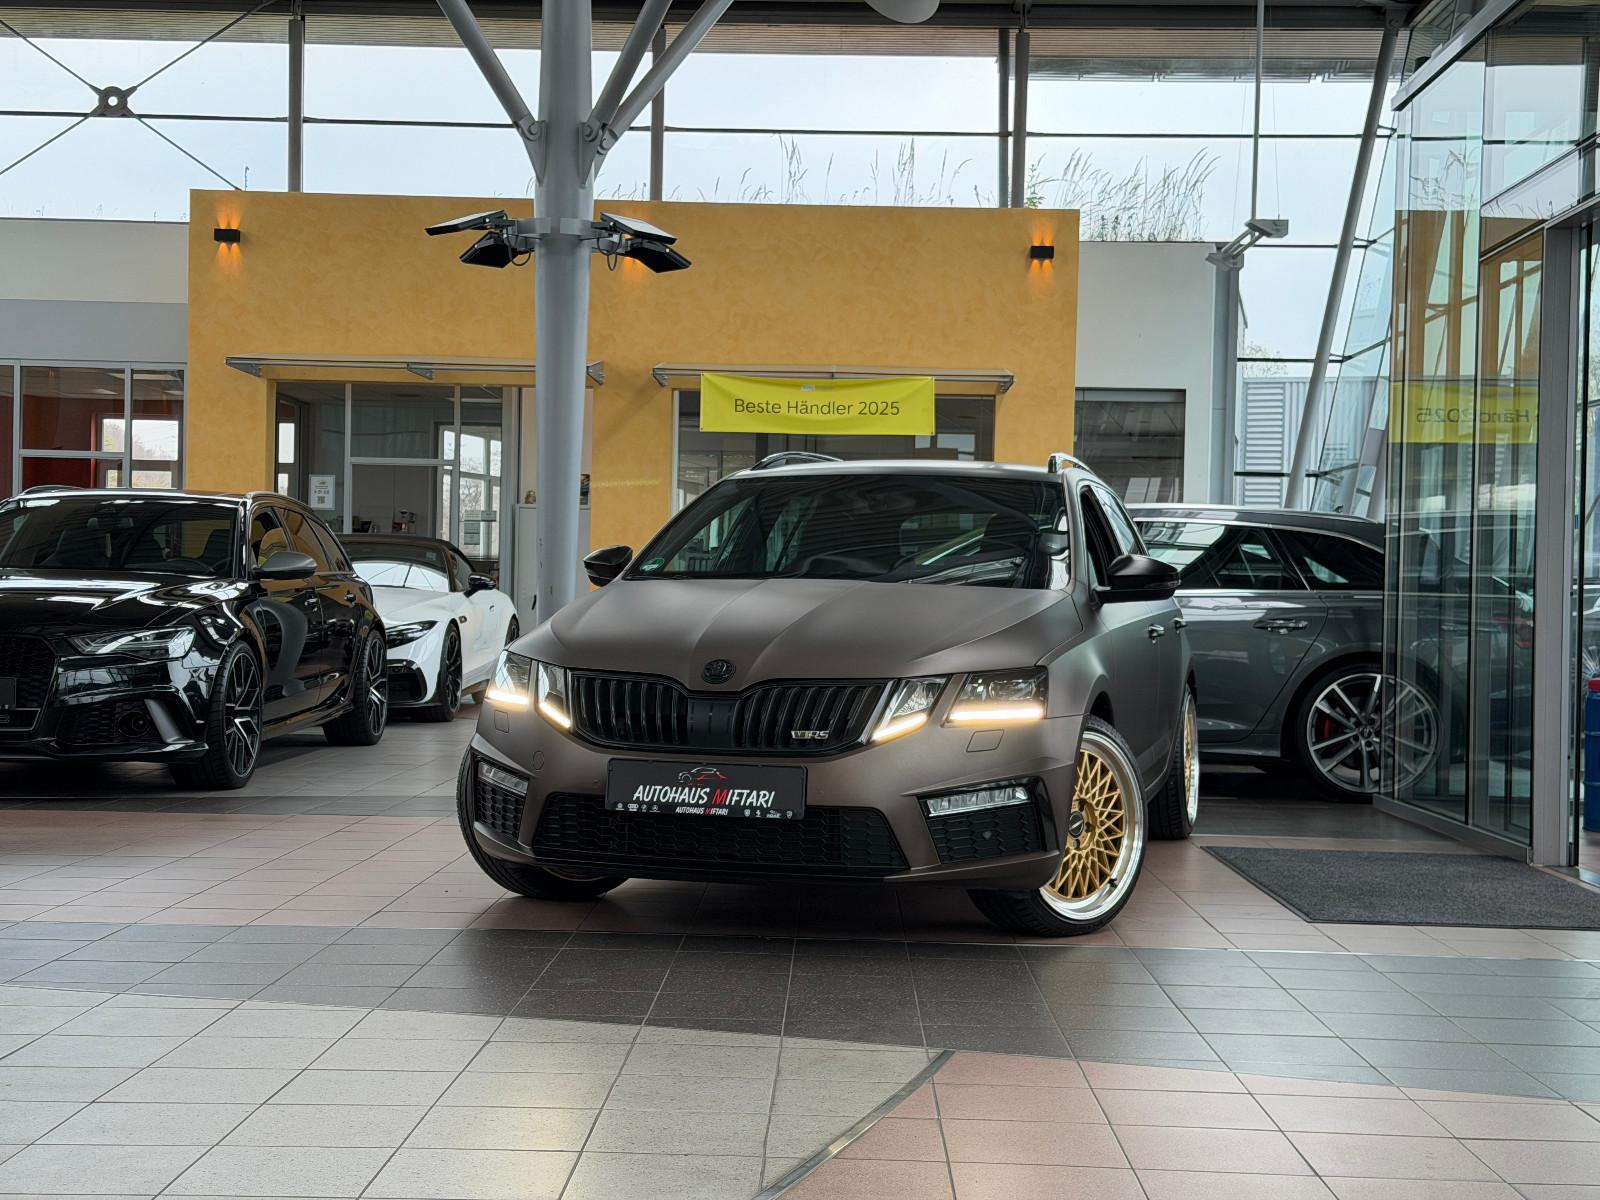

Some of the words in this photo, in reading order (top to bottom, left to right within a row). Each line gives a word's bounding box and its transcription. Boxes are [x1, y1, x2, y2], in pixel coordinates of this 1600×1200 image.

[734, 398, 782, 415] Beste
[787, 400, 854, 416] Händler
[858, 401, 900, 416] 2025
[633, 784, 711, 805] AUTOHAUS
[711, 788, 776, 808] MIFTARI
[675, 806, 705, 815] AUTOHAUS
[705, 807, 729, 816] MIFTARI
